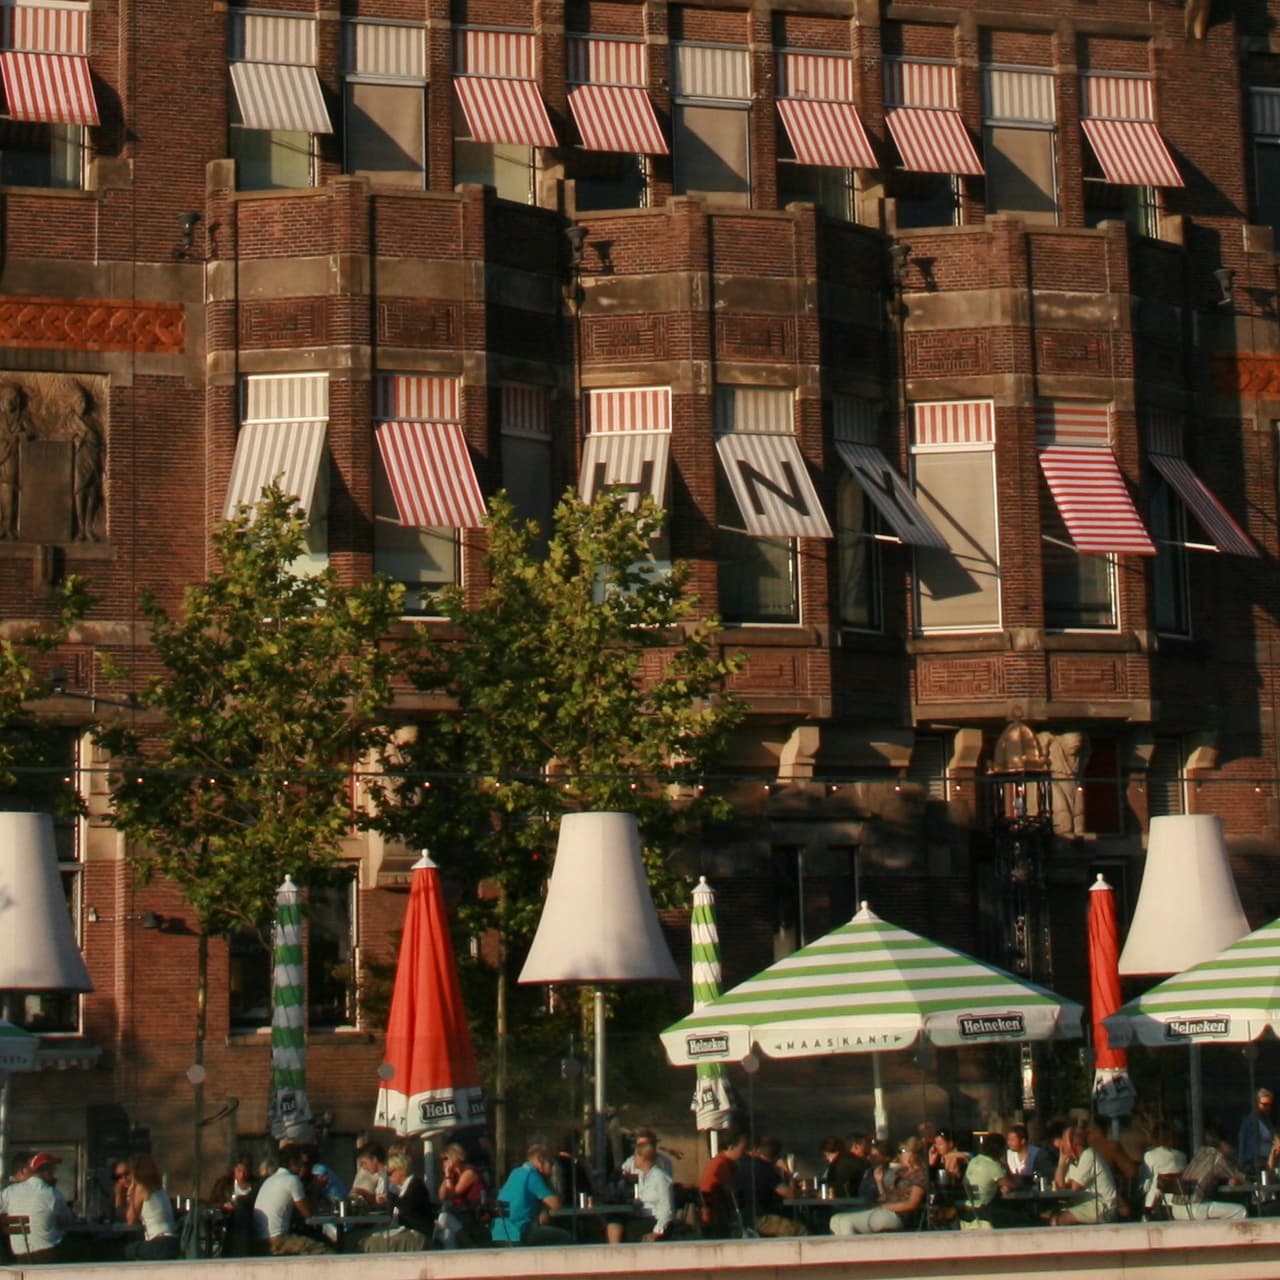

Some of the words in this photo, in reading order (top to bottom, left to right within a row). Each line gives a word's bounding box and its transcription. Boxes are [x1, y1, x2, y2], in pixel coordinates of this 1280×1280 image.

[735, 459, 811, 517] N
[963, 1017, 1021, 1035] Heineken
[1170, 1020, 1226, 1035] Heineken
